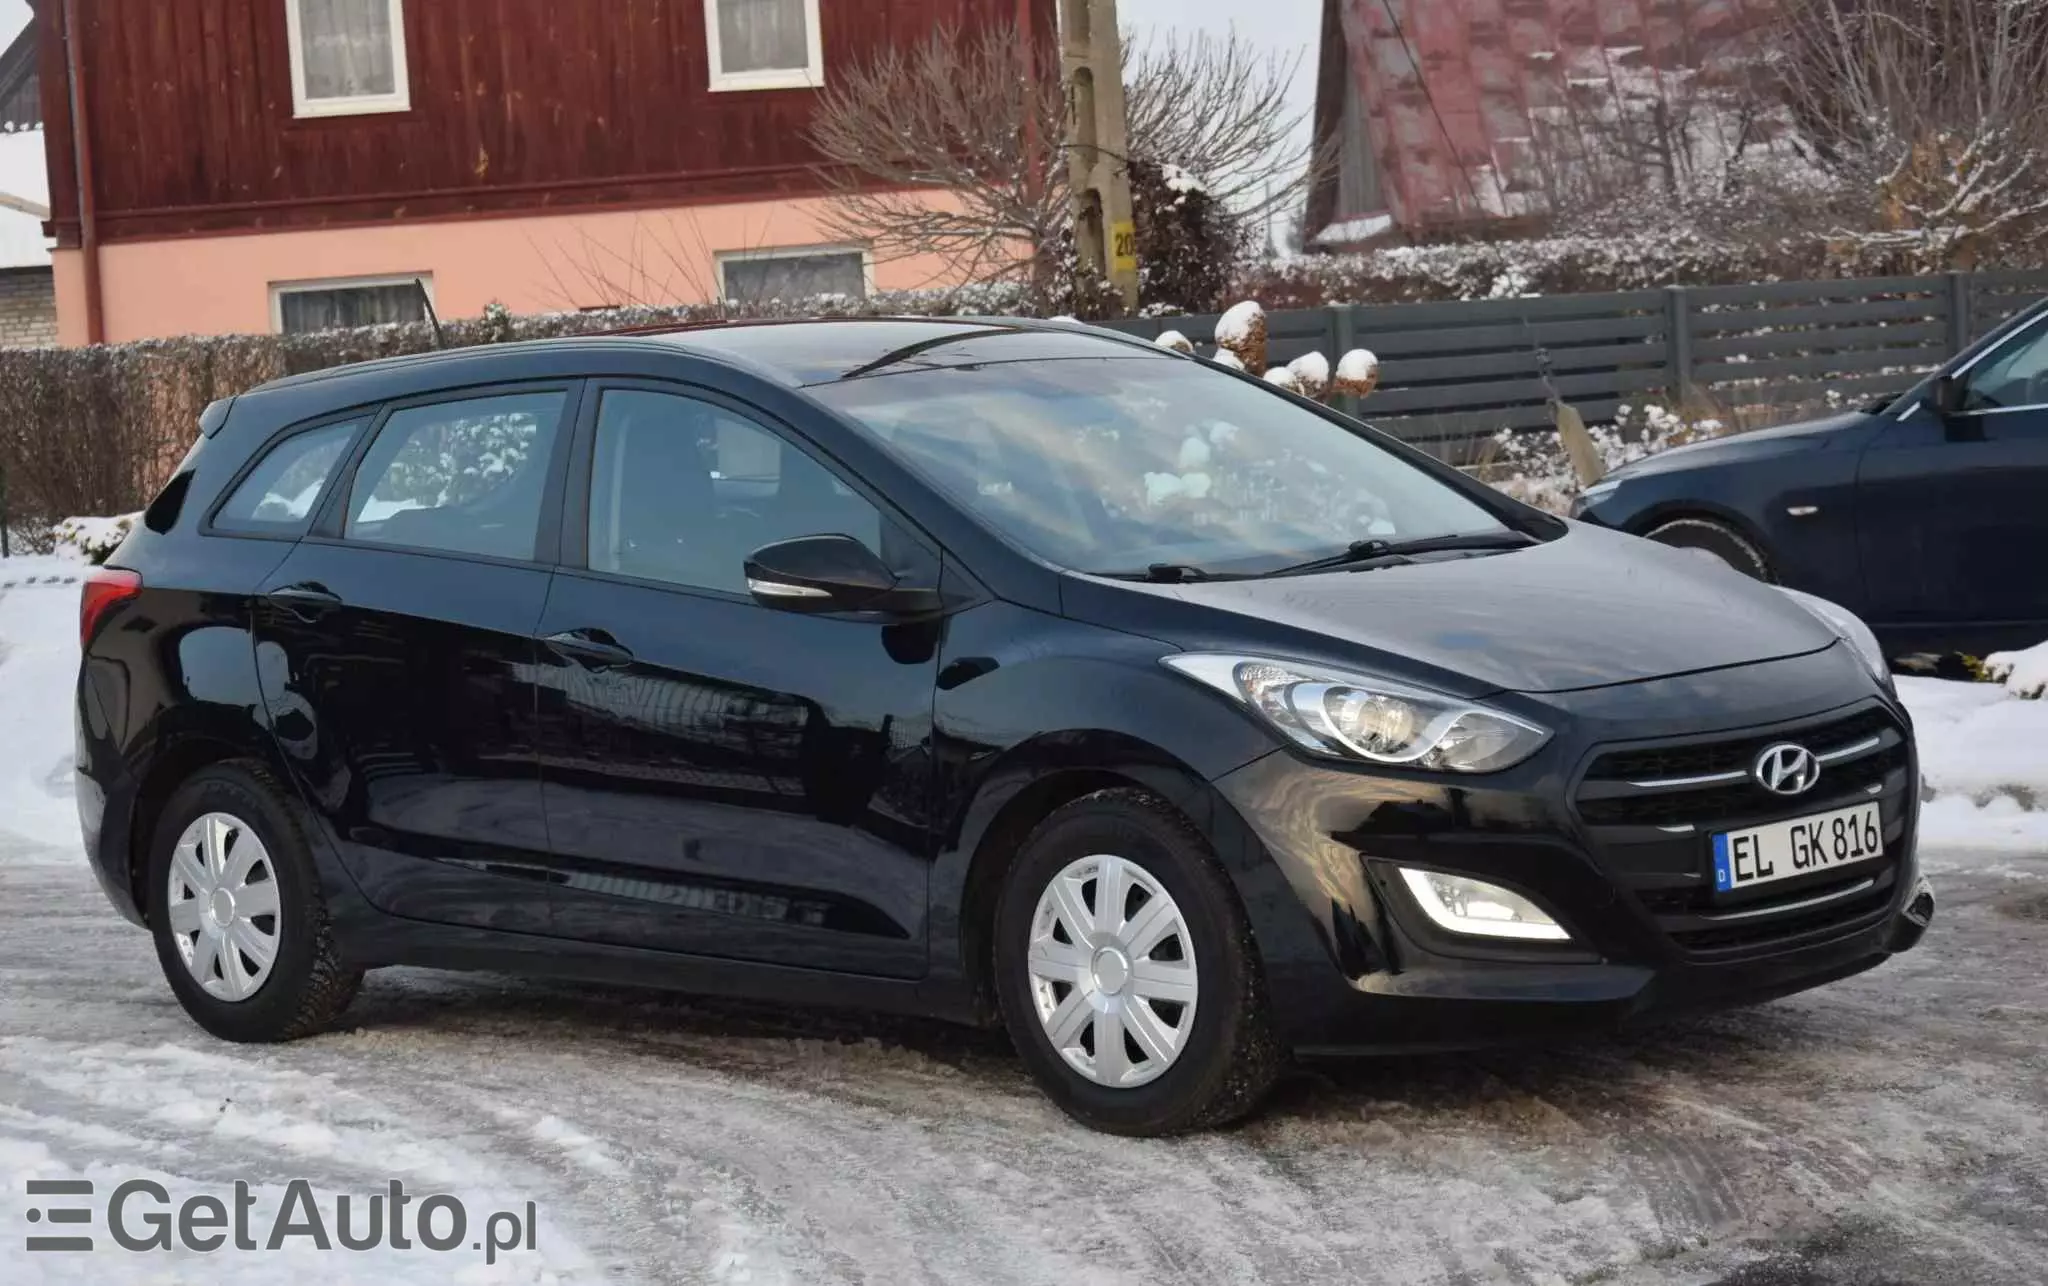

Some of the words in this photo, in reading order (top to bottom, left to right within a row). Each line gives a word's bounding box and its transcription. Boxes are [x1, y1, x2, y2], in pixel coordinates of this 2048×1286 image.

[1115, 233, 1134, 257] 20
[1733, 834, 1774, 882] EL
[1790, 821, 1828, 869] GK
[1832, 811, 1878, 861] 816
